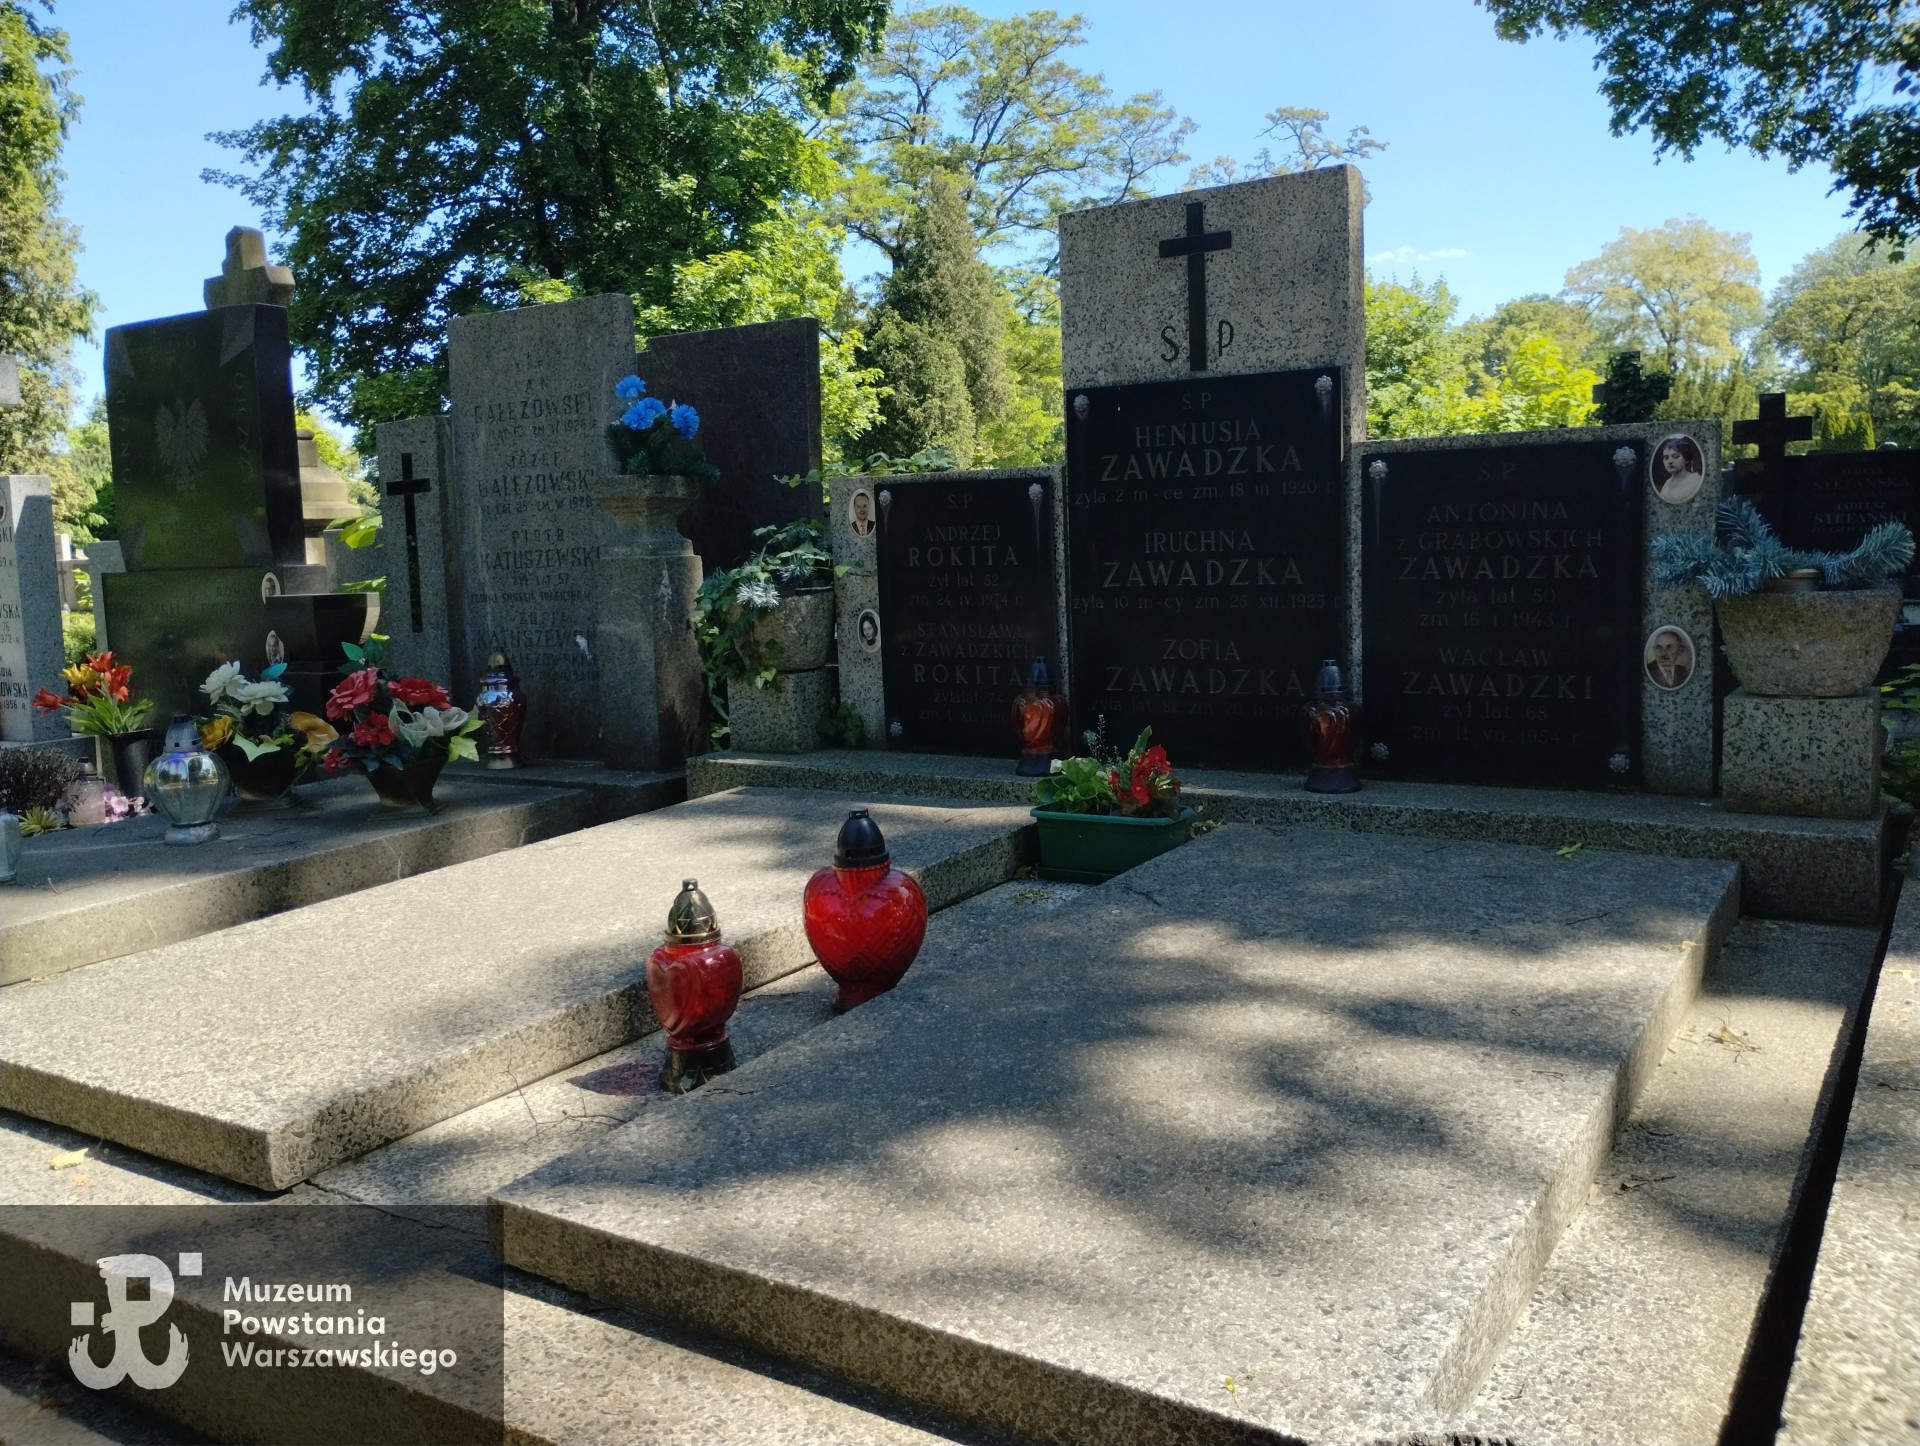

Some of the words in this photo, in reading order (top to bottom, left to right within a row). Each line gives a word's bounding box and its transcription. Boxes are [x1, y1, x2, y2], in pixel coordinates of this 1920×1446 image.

[1218, 320, 1234, 357] P
[1135, 418, 1263, 449] HENIUSIA
[1100, 443, 1305, 483] ZAWADZKA
[1116, 488, 1124, 502] 2
[1281, 479, 1318, 495] 1920
[1427, 502, 1569, 523] ANTONINA
[511, 528, 564, 544] PIOTR
[923, 525, 1001, 542] ANDRZEJ
[1144, 530, 1256, 554] IRUCHNA
[1418, 528, 1603, 551] GRABOWSKICH
[480, 546, 601, 572] KATUSZEWSKI
[908, 546, 1019, 567] ROKITA
[1399, 554, 1599, 581] ZAWADZKA
[957, 572, 974, 587] lat
[984, 574, 999, 587] 52
[1102, 557, 1305, 588] ZAWADZKA
[937, 592, 951, 606] 24
[1114, 595, 1129, 609] 10
[1491, 586, 1517, 604] lat
[1531, 588, 1556, 604] 50
[1513, 611, 1555, 628] 1943
[916, 642, 1035, 659] ZAWADZKICH
[1162, 638, 1242, 661] ZOFIA
[1438, 647, 1551, 667] WACŁAW
[913, 664, 1023, 687] ROKITA
[1105, 666, 1305, 697] ZAWADZKA
[1402, 671, 1592, 699] ZAWADZKI
[1485, 701, 1512, 719] lat
[1525, 705, 1548, 720] 68
[1520, 729, 1560, 744] 1954
